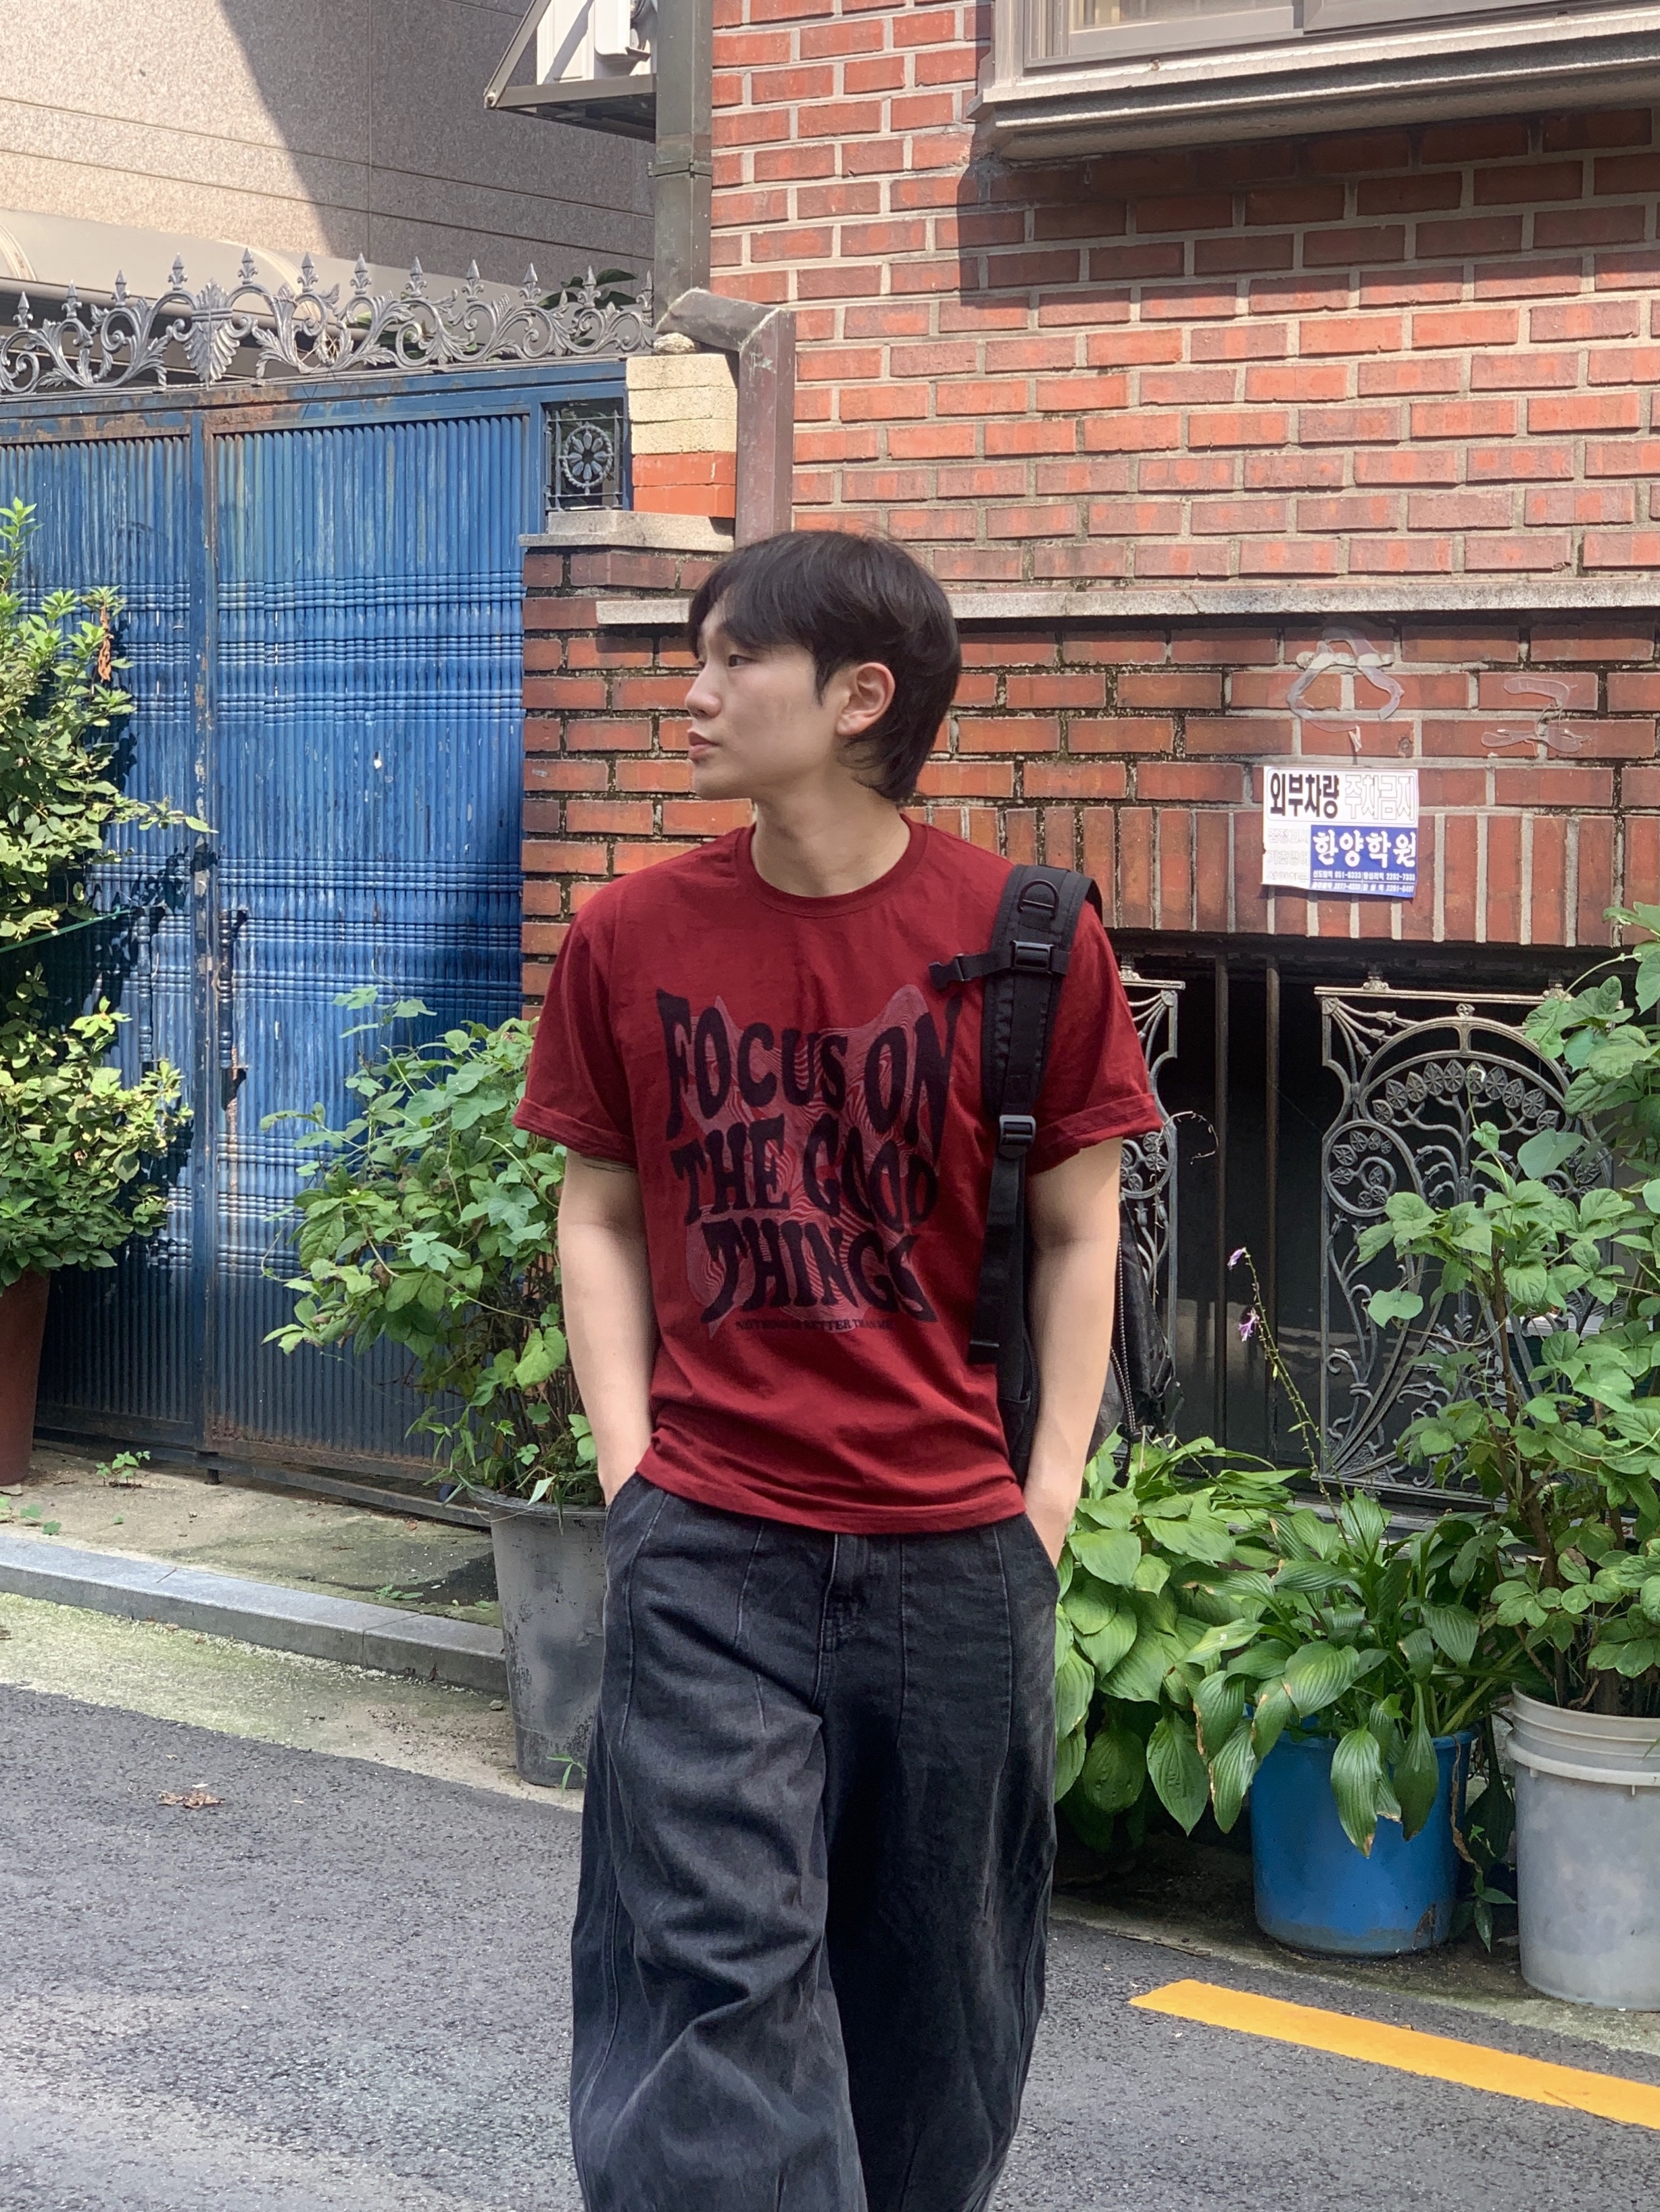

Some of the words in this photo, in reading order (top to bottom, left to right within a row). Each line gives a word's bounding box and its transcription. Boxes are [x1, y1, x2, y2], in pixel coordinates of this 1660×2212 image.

[1270, 772, 1339, 819] 외부차량
[1345, 775, 1415, 820] 주차금지
[1267, 850, 1309, 866] 기초영어
[1313, 829, 1416, 868] 한양학원
[656, 988, 848, 1140] FOCUS
[864, 996, 963, 1162] ON
[670, 1114, 790, 1225] THE
[802, 1112, 938, 1233] GOOD
[700, 1217, 937, 1323] THINGS
